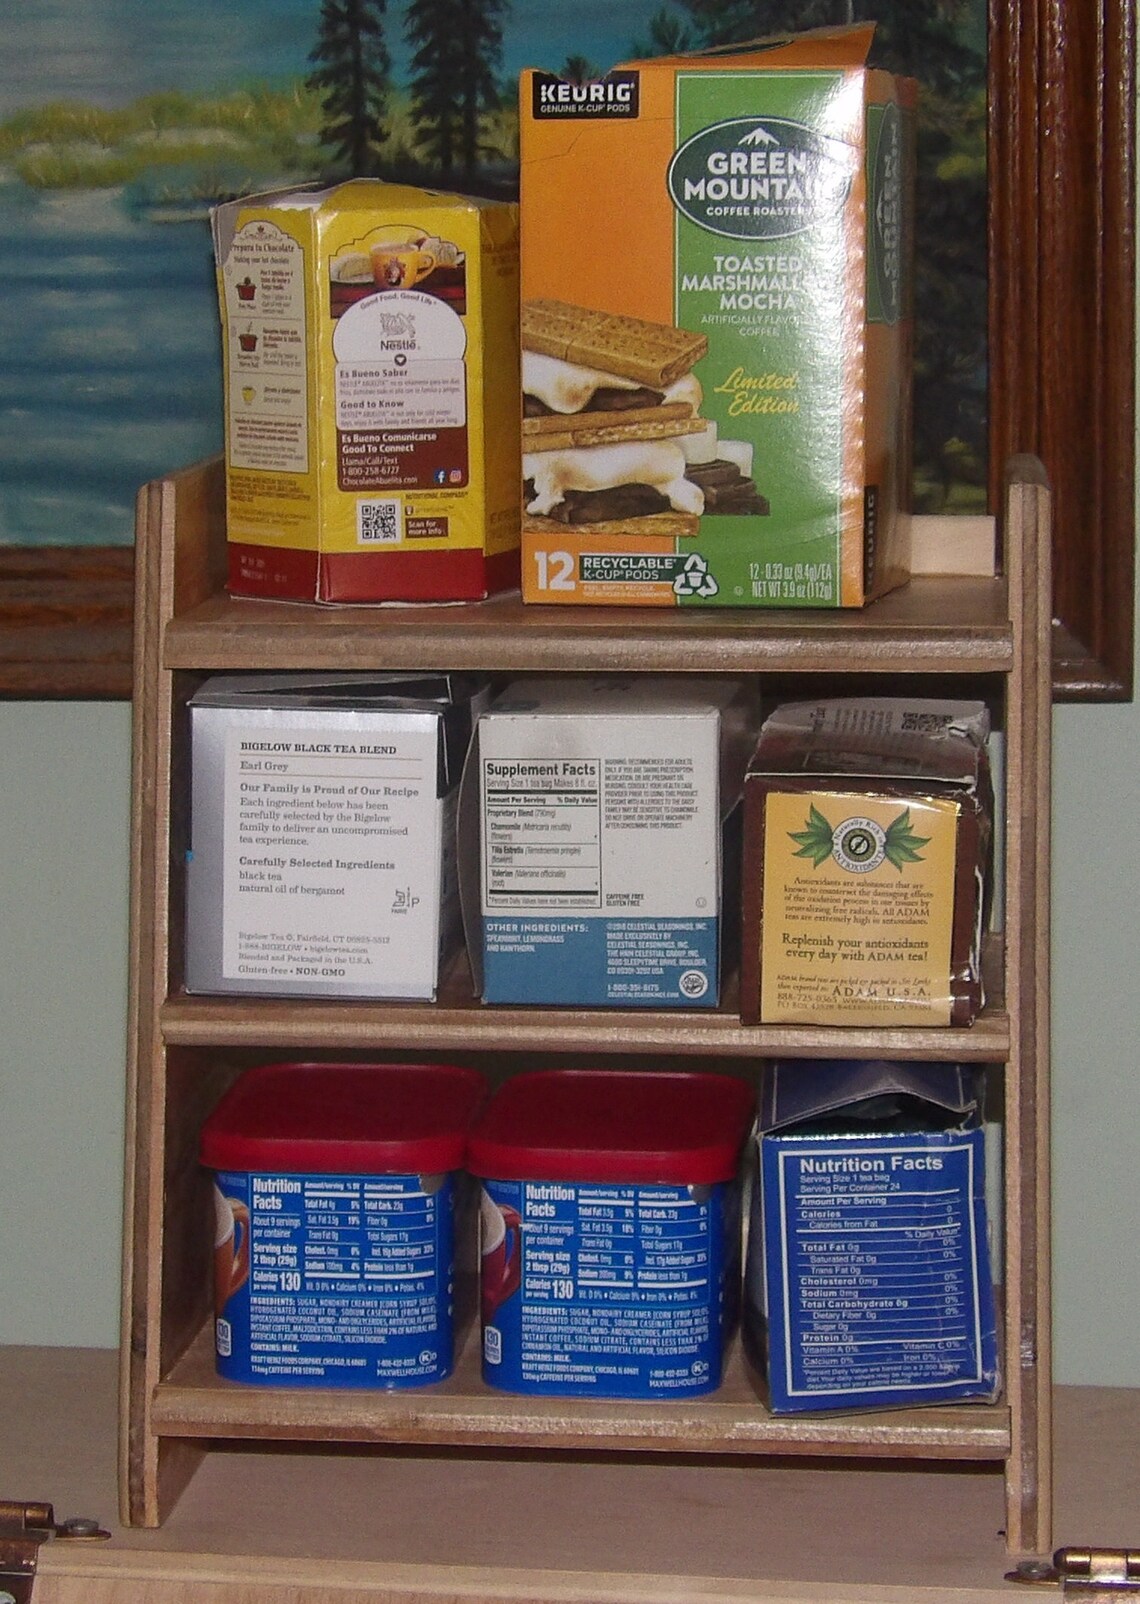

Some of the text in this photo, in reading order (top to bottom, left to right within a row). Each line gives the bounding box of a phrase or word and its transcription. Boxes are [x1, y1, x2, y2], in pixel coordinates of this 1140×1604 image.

[541, 84, 630, 102] KEURIG
[541, 104, 576, 113] GENUINE
[607, 104, 630, 112] PODS
[708, 152, 806, 175] GREEN
[706, 206, 750, 216] COFFEE
[713, 256, 802, 273] TOASTED
[361, 298, 378, 310] Good
[400, 293, 419, 301] Good
[720, 294, 798, 311] MOCHA
[701, 314, 761, 325] ARTIFICIALLY
[740, 327, 779, 337] COFFEE
[340, 370, 349, 378] Es
[383, 369, 408, 377] Saber
[714, 367, 798, 393] Limited
[341, 401, 365, 409] Good
[379, 400, 404, 408] Know
[728, 393, 799, 417] Edition
[342, 432, 437, 443] Es Bueno Comunicarse
[343, 444, 414, 454] Good To Connect
[534, 551, 576, 591] 12
[625, 570, 659, 580] PODS
[753, 582, 766, 598] NET
[769, 582, 781, 598] WT
[783, 582, 795, 598] 3.9
[241, 742, 397, 755] BIGELOW BLACK TEA BLEND
[240, 761, 289, 773] Earl Grey
[487, 763, 596, 778] Supplement Facts
[240, 783, 419, 798] Our Family is Proud of Our Recipe
[240, 797, 389, 811] Each ingredient below has been
[240, 811, 391, 824] carefully selected by the Bigelow
[240, 823, 408, 838] family to deliver an uncompromised
[239, 836, 309, 847] tea experience.
[239, 856, 395, 871] Carefully Selected Ingredients
[239, 871, 282, 881] black tea
[239, 884, 345, 897] natural oil of bergamot
[487, 924, 589, 932] OTHER INGREDIENTS:
[782, 933, 929, 952] Replenish your antioxidants
[786, 949, 928, 963] every day with ADAM tea!
[295, 968, 346, 977] NON-GMO
[832, 986, 877, 997] ADAM
[800, 1156, 943, 1173] Nutrition Facts
[800, 1175, 830, 1184] Serving
[875, 1174, 890, 1184] bag
[253, 1179, 301, 1194] Nutrition
[800, 1183, 900, 1194] Serving Per Container 24
[526, 1185, 575, 1201] Nutrition
[253, 1195, 282, 1210] Facts
[801, 1198, 835, 1206] Amount
[854, 1197, 887, 1206] Serving
[526, 1202, 556, 1217] Facts
[802, 1210, 841, 1218] Calories
[809, 1221, 843, 1229] Calories
[253, 1243, 298, 1255] Serving size
[802, 1244, 860, 1253] Total Fat 0g
[253, 1255, 297, 1267] 2 tbsp (29g)
[526, 1250, 571, 1262] Serving size
[253, 1271, 278, 1282] Calories
[280, 1272, 300, 1291] 130
[859, 1278, 878, 1287] 0mg
[526, 1278, 551, 1290] Calories
[553, 1280, 574, 1299] 130
[801, 1289, 859, 1298] Sodium 0mg
[828, 1300, 894, 1309] Carbohydrate
[896, 1300, 908, 1308] 0g
[803, 1334, 853, 1342] Protein 0g
